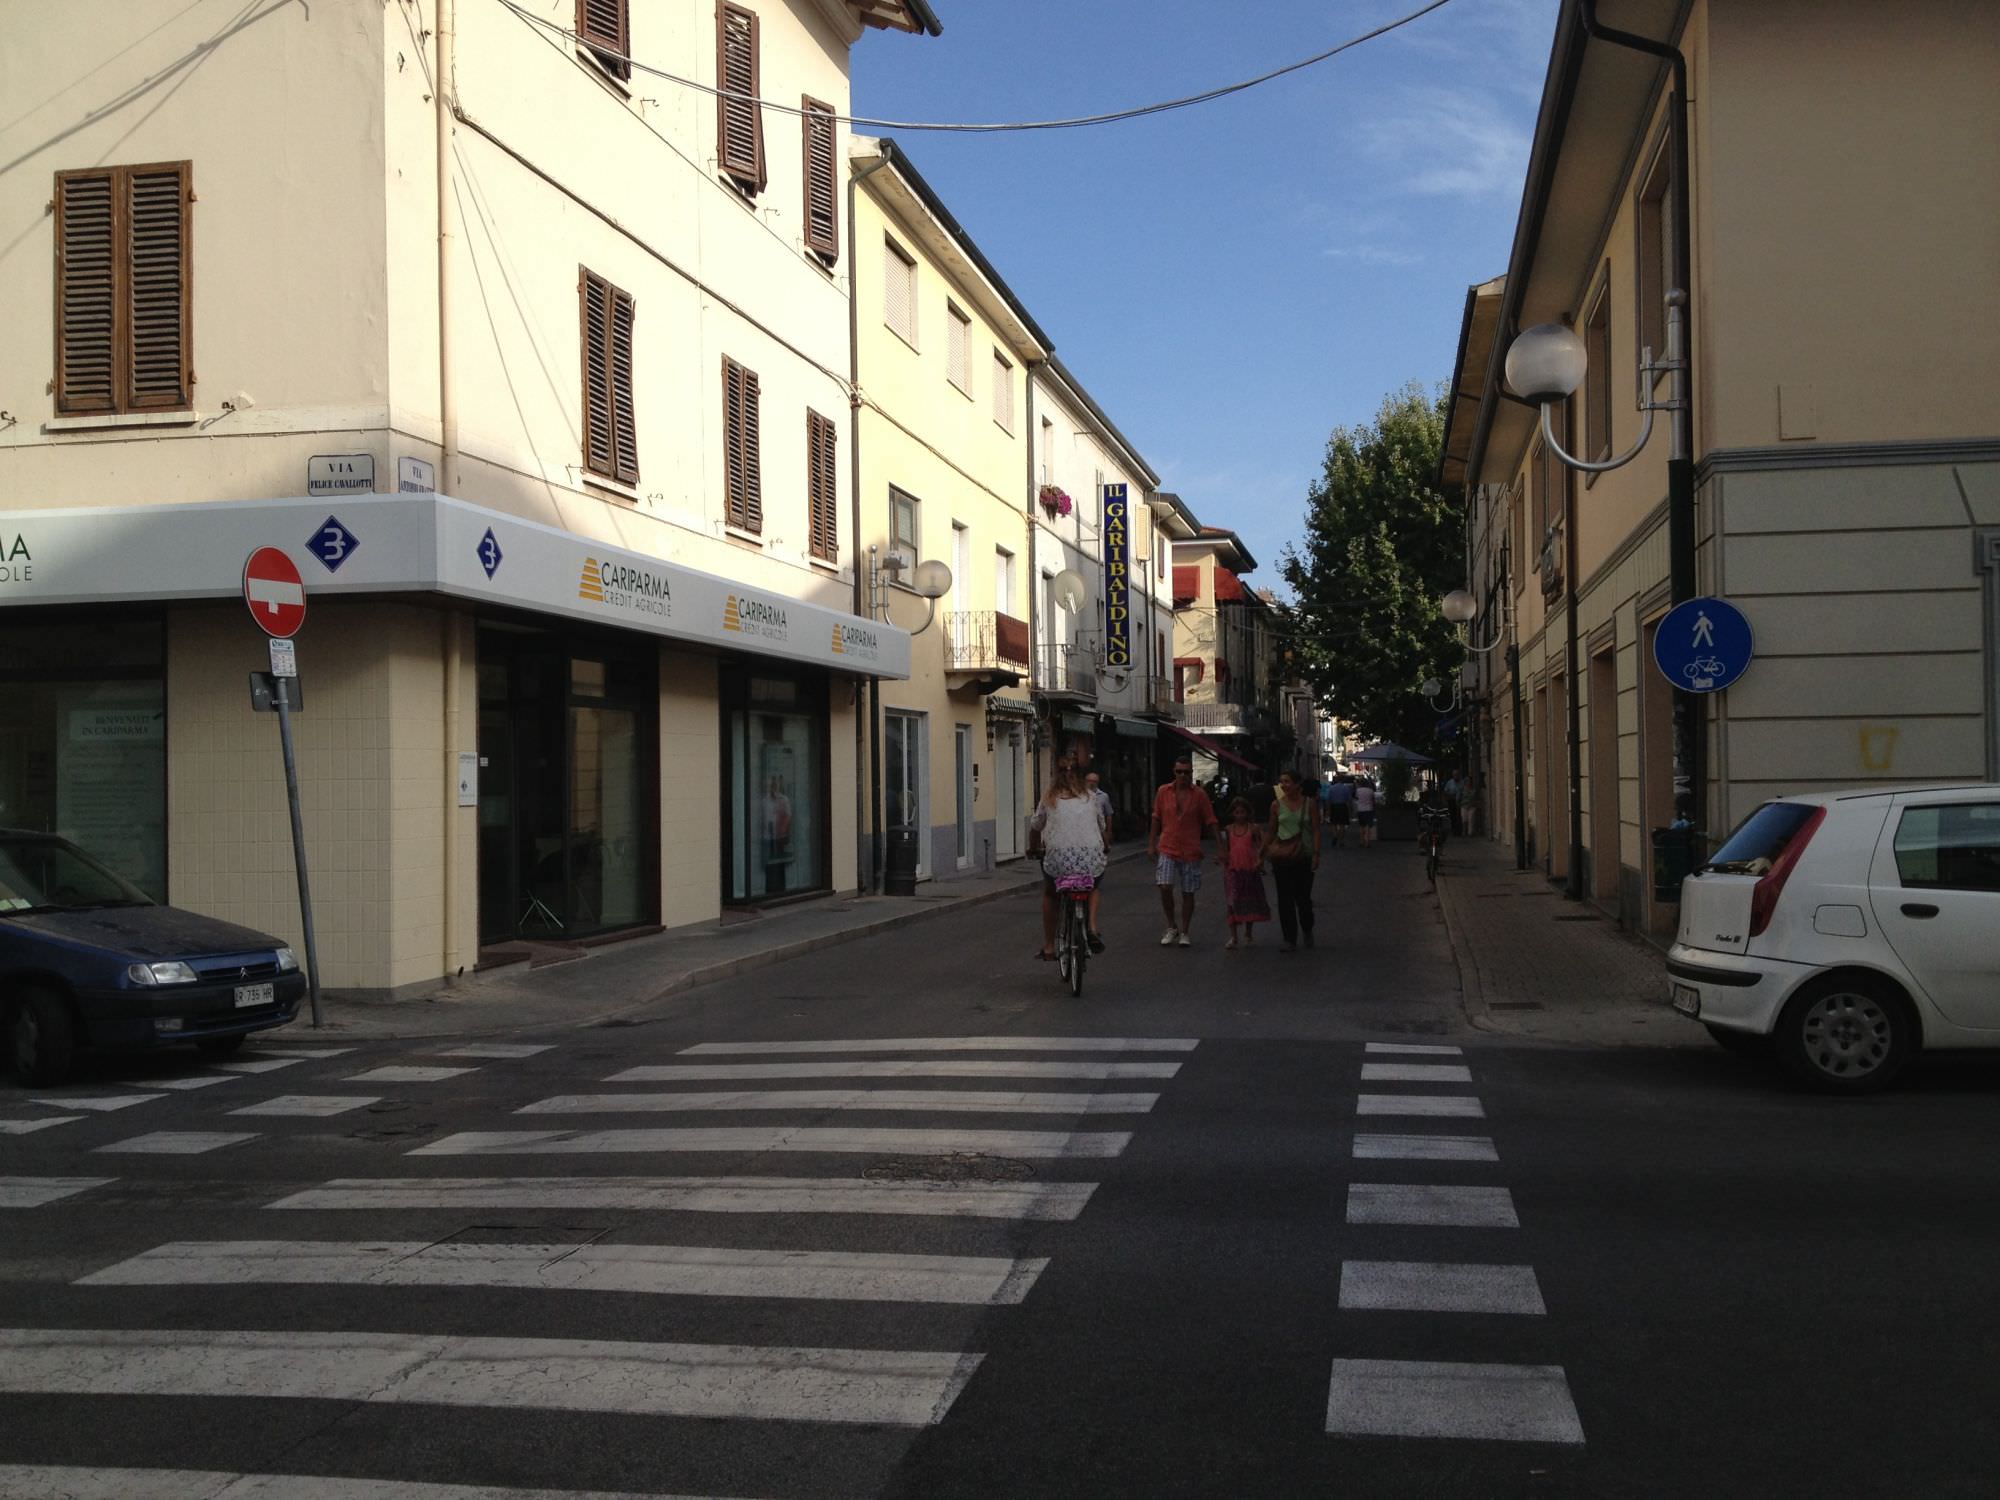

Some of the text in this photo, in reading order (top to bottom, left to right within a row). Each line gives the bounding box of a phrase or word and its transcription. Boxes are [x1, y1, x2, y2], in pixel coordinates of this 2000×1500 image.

[329, 463, 353, 472] VIA
[310, 478, 372, 489] FELICE CAVALLOTTI
[1108, 485, 1124, 497] IL
[0, 533, 32, 561] A
[601, 562, 671, 601] CARIPARMA
[1107, 503, 1128, 664] GARIBALDINO
[738, 598, 786, 629] CARIPARMA
[841, 625, 877, 649] CARIPARMA
